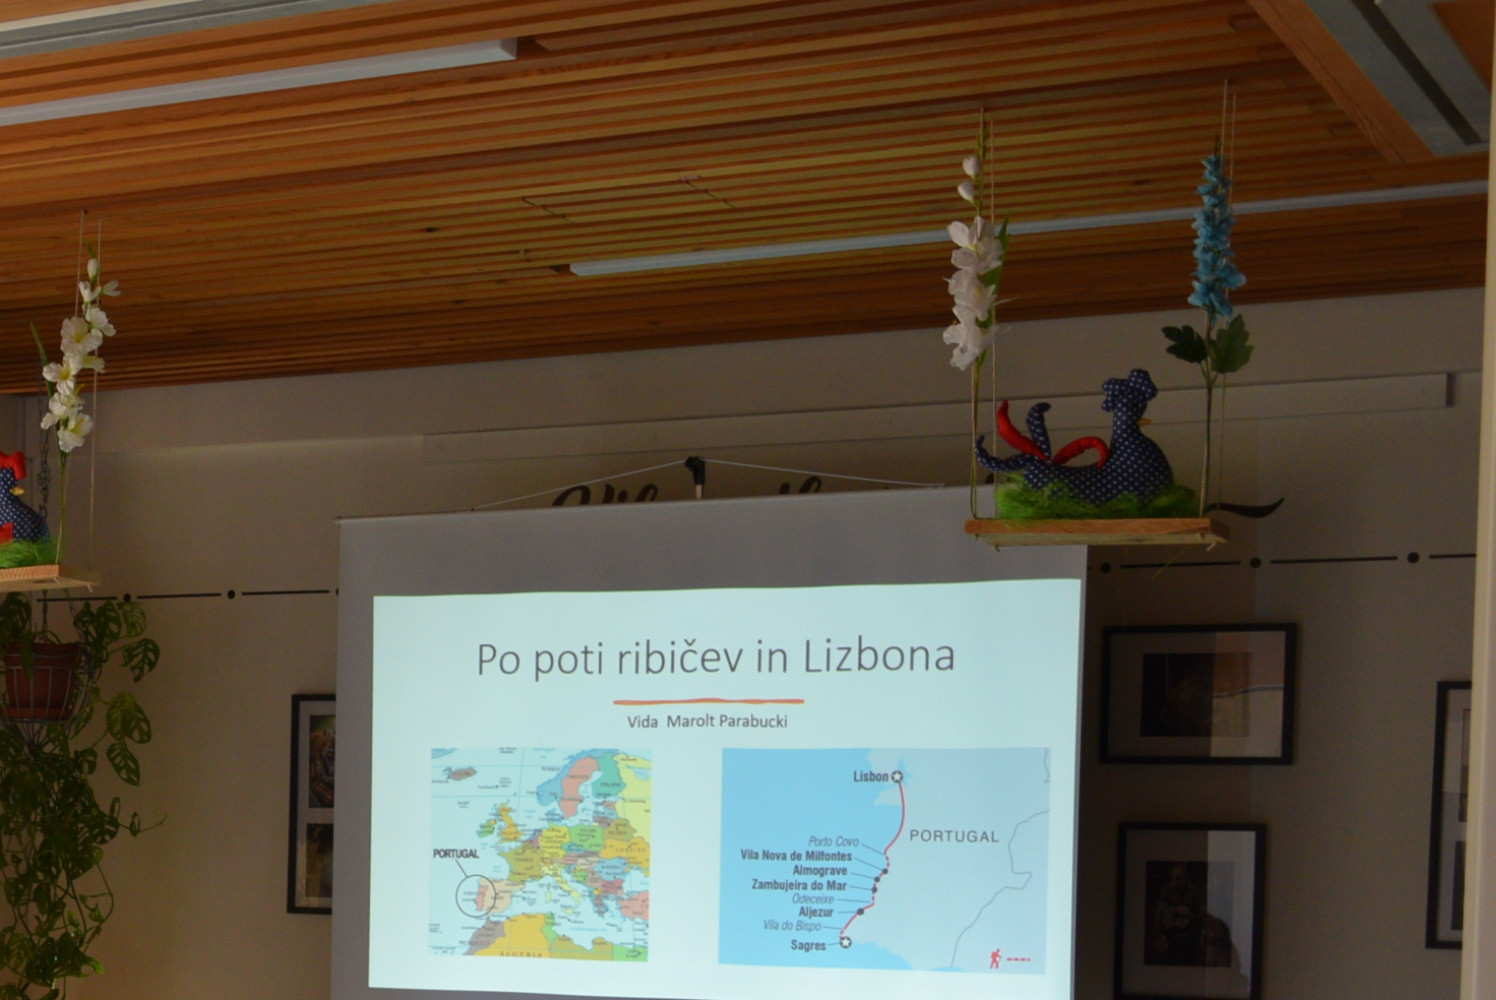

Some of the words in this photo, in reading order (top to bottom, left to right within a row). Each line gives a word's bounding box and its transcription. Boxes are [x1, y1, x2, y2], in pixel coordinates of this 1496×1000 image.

[479, 644, 520, 675] Po
[535, 642, 602, 682] poti
[619, 639, 743, 674] ribičev
[758, 639, 787, 673] in
[806, 635, 954, 672] Lizbona
[627, 715, 658, 728] Vida
[667, 713, 715, 727] Marolt
[720, 714, 787, 728] Parabucki
[854, 771, 889, 782] Lisbon
[808, 835, 832, 847] Porto
[836, 835, 859, 847] Covo
[910, 829, 999, 843] PORTUGAL
[432, 847, 480, 859] PORTUGAL
[741, 849, 759, 860] Vila
[762, 850, 787, 861] Nova
[790, 850, 802, 861] de
[806, 850, 852, 861] Milfontes
[793, 865, 847, 878] Almograve
[752, 879, 808, 892] Zambujeira
[811, 880, 823, 890] do
[827, 880, 847, 890] Mar
[792, 893, 834, 904] Odeceixe
[799, 906, 833, 919] Aljezur
[764, 919, 779, 930] Vila
[781, 920, 793, 931] do
[795, 920, 821, 933] Bispo
[791, 939, 826, 953] Sagres
